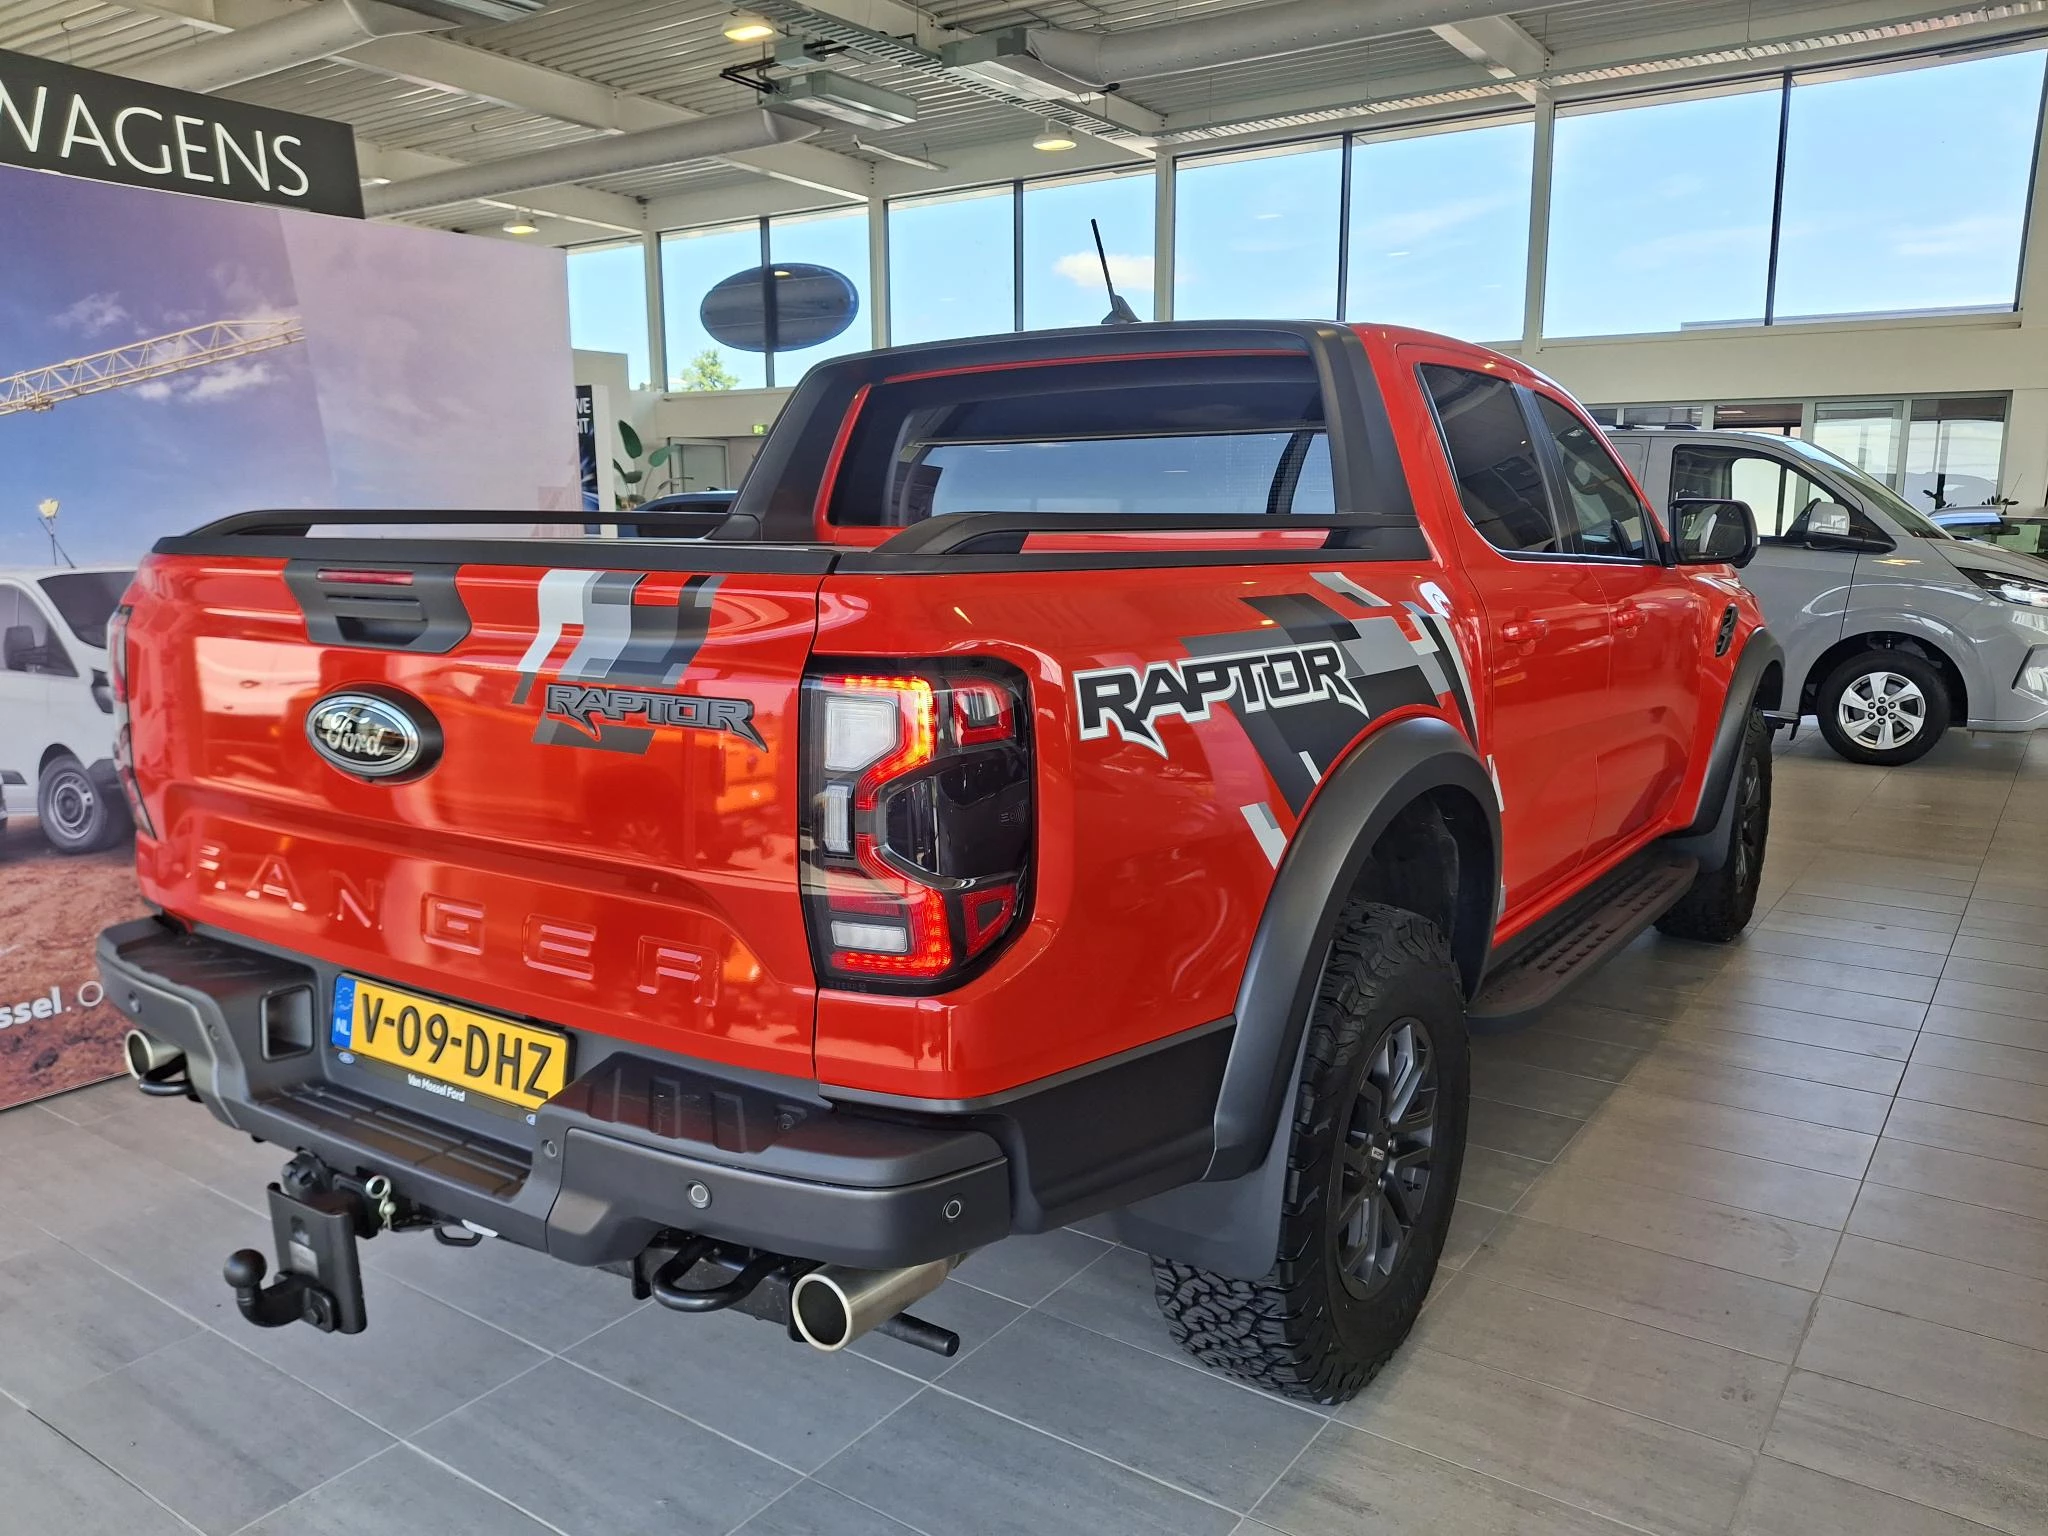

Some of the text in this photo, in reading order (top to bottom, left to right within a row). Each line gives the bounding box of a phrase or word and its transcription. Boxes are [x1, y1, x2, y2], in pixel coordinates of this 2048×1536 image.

[326, 711, 386, 757] Ford
[546, 684, 769, 752] RAPTOR
[1073, 641, 1369, 760] RAPTOR
[362, 993, 552, 1100] V-09-DHZ
[407, 1073, 421, 1088] Van
[446, 1085, 466, 1102] Ford
